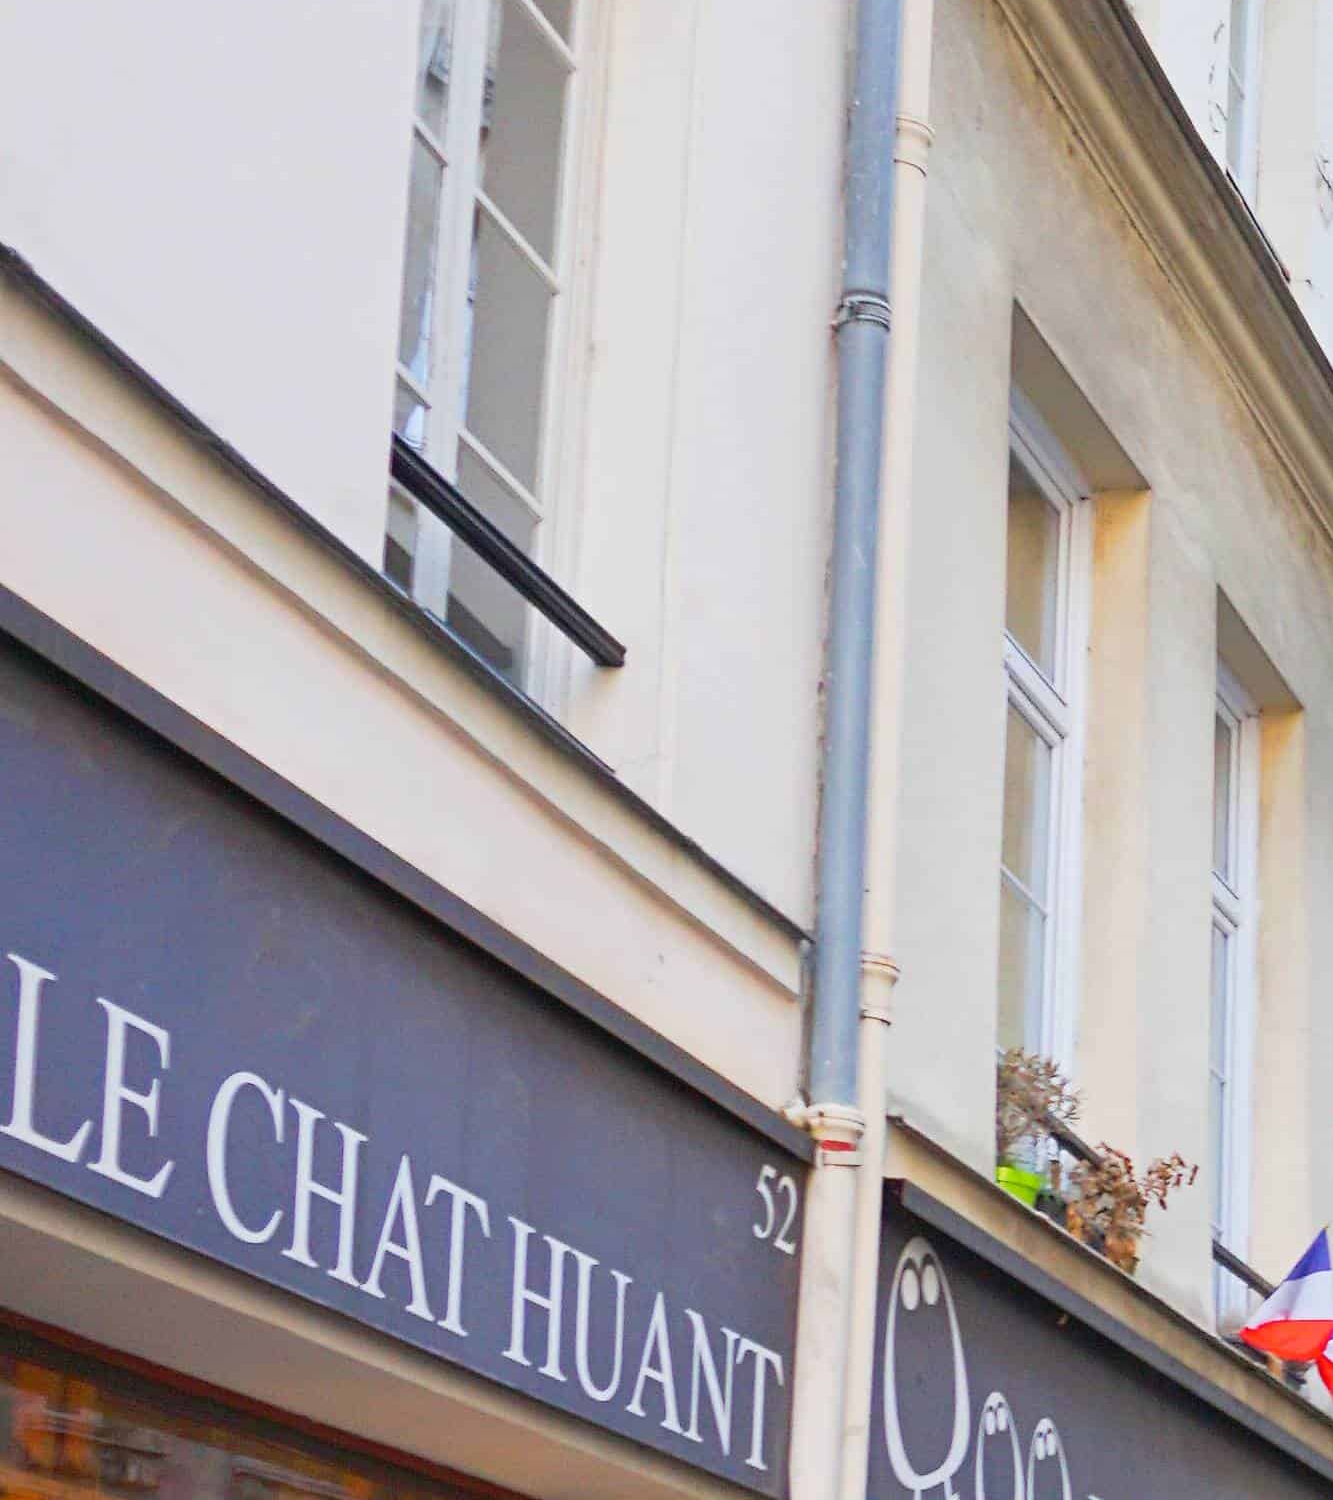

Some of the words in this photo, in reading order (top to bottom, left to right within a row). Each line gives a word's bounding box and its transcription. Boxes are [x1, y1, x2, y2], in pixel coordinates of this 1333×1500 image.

[0, 953, 175, 1199] LE
[206, 1071, 491, 1338] CHAT
[502, 1215, 784, 1472] HUANT
[752, 1164, 799, 1256] 52
